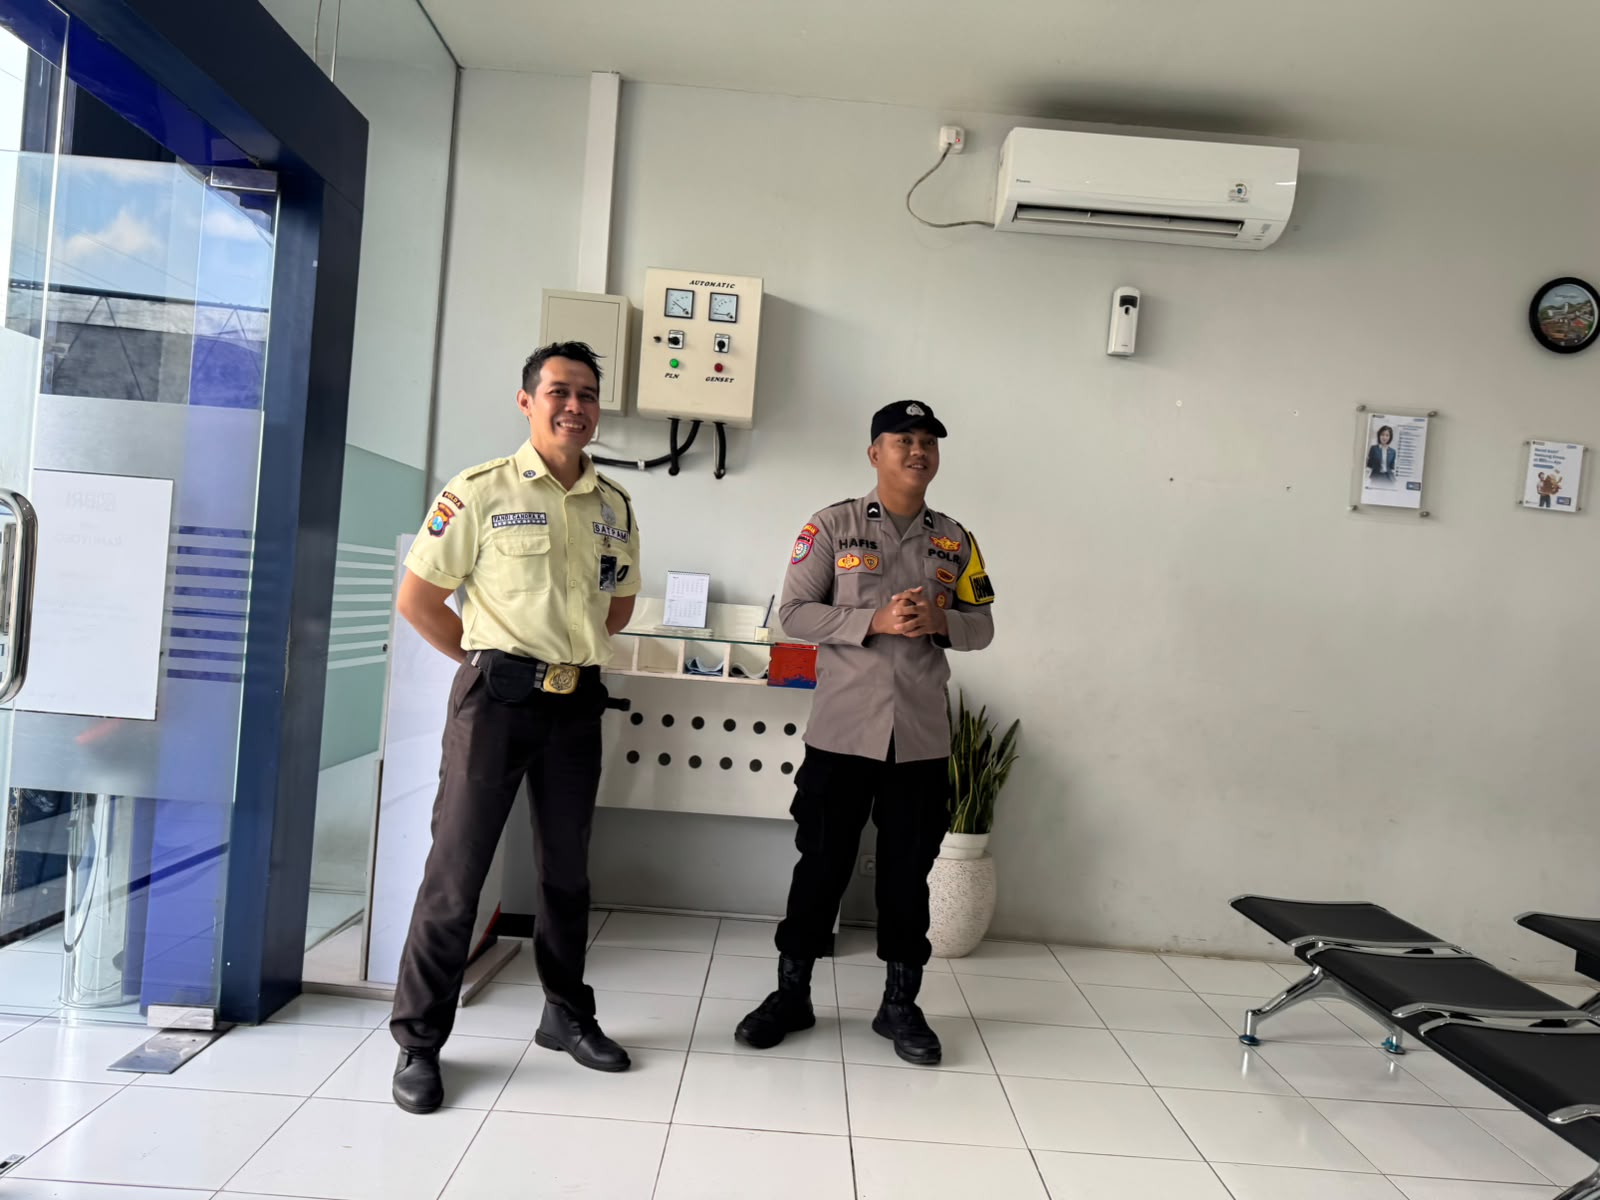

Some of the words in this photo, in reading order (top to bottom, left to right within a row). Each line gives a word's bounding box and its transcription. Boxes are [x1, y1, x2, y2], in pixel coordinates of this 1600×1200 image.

[689, 279, 736, 289] AUTOMATIC
[664, 371, 680, 379] PLN
[705, 376, 735, 384] GENSET
[594, 524, 627, 540] SATPAM
[838, 537, 878, 550] HAFIS
[927, 548, 962, 565] POLR
